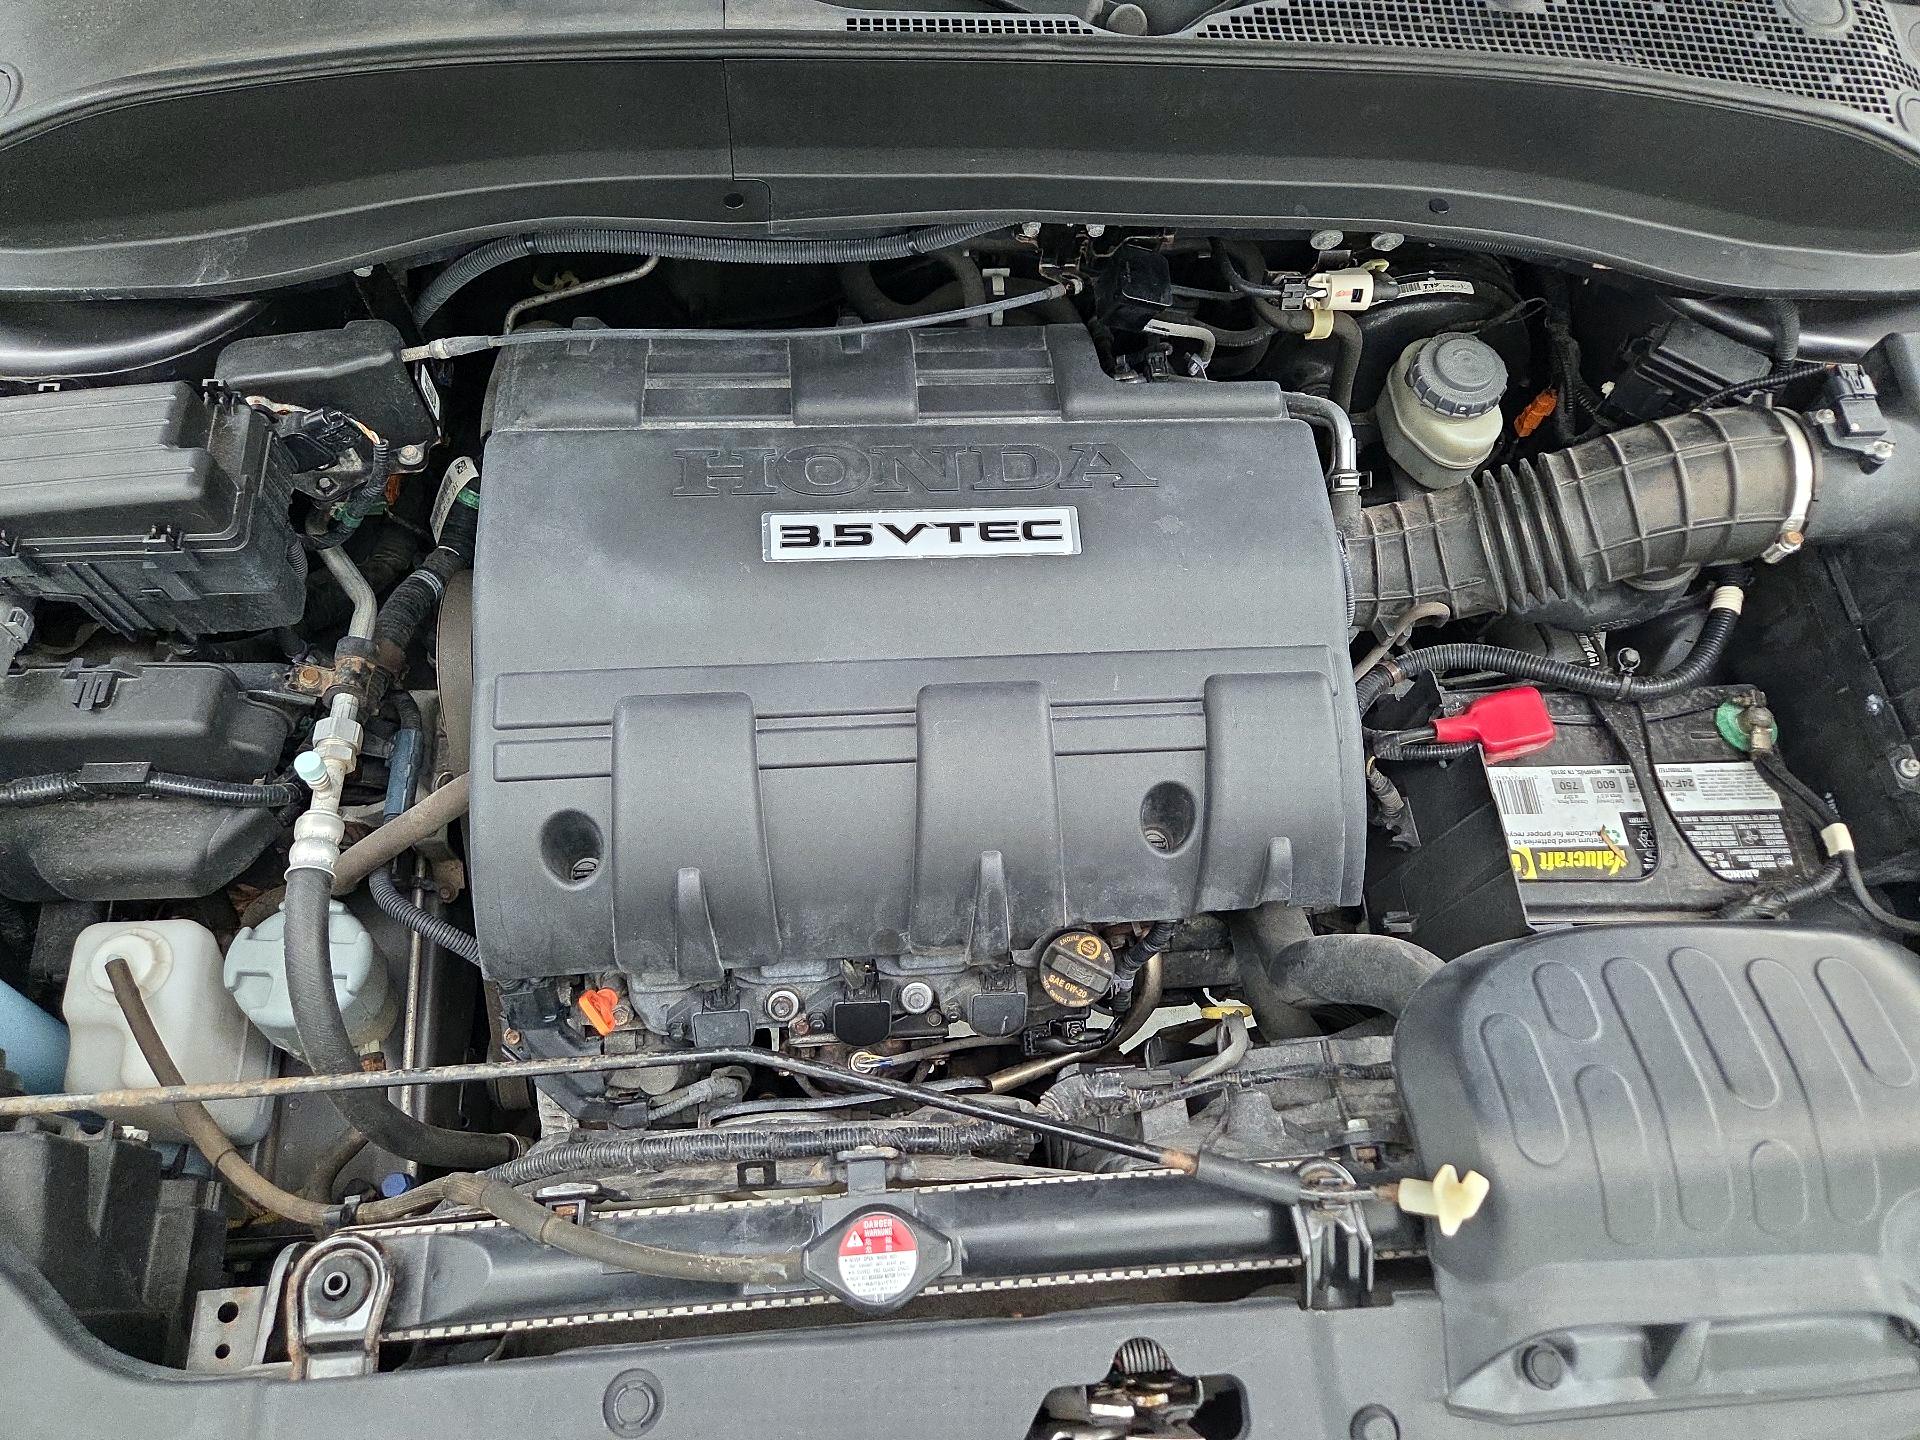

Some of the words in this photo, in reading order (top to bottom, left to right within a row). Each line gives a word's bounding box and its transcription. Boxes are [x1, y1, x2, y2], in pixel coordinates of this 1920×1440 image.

[673, 442, 1159, 497] HONDA
[1560, 781, 1579, 790] 750
[1597, 781, 1615, 789] 600
[1537, 850, 1628, 876] Valucraft
[1048, 974, 1066, 988] SAE
[1064, 982, 1088, 999] 0W-20
[864, 1219, 893, 1228] DANGER
